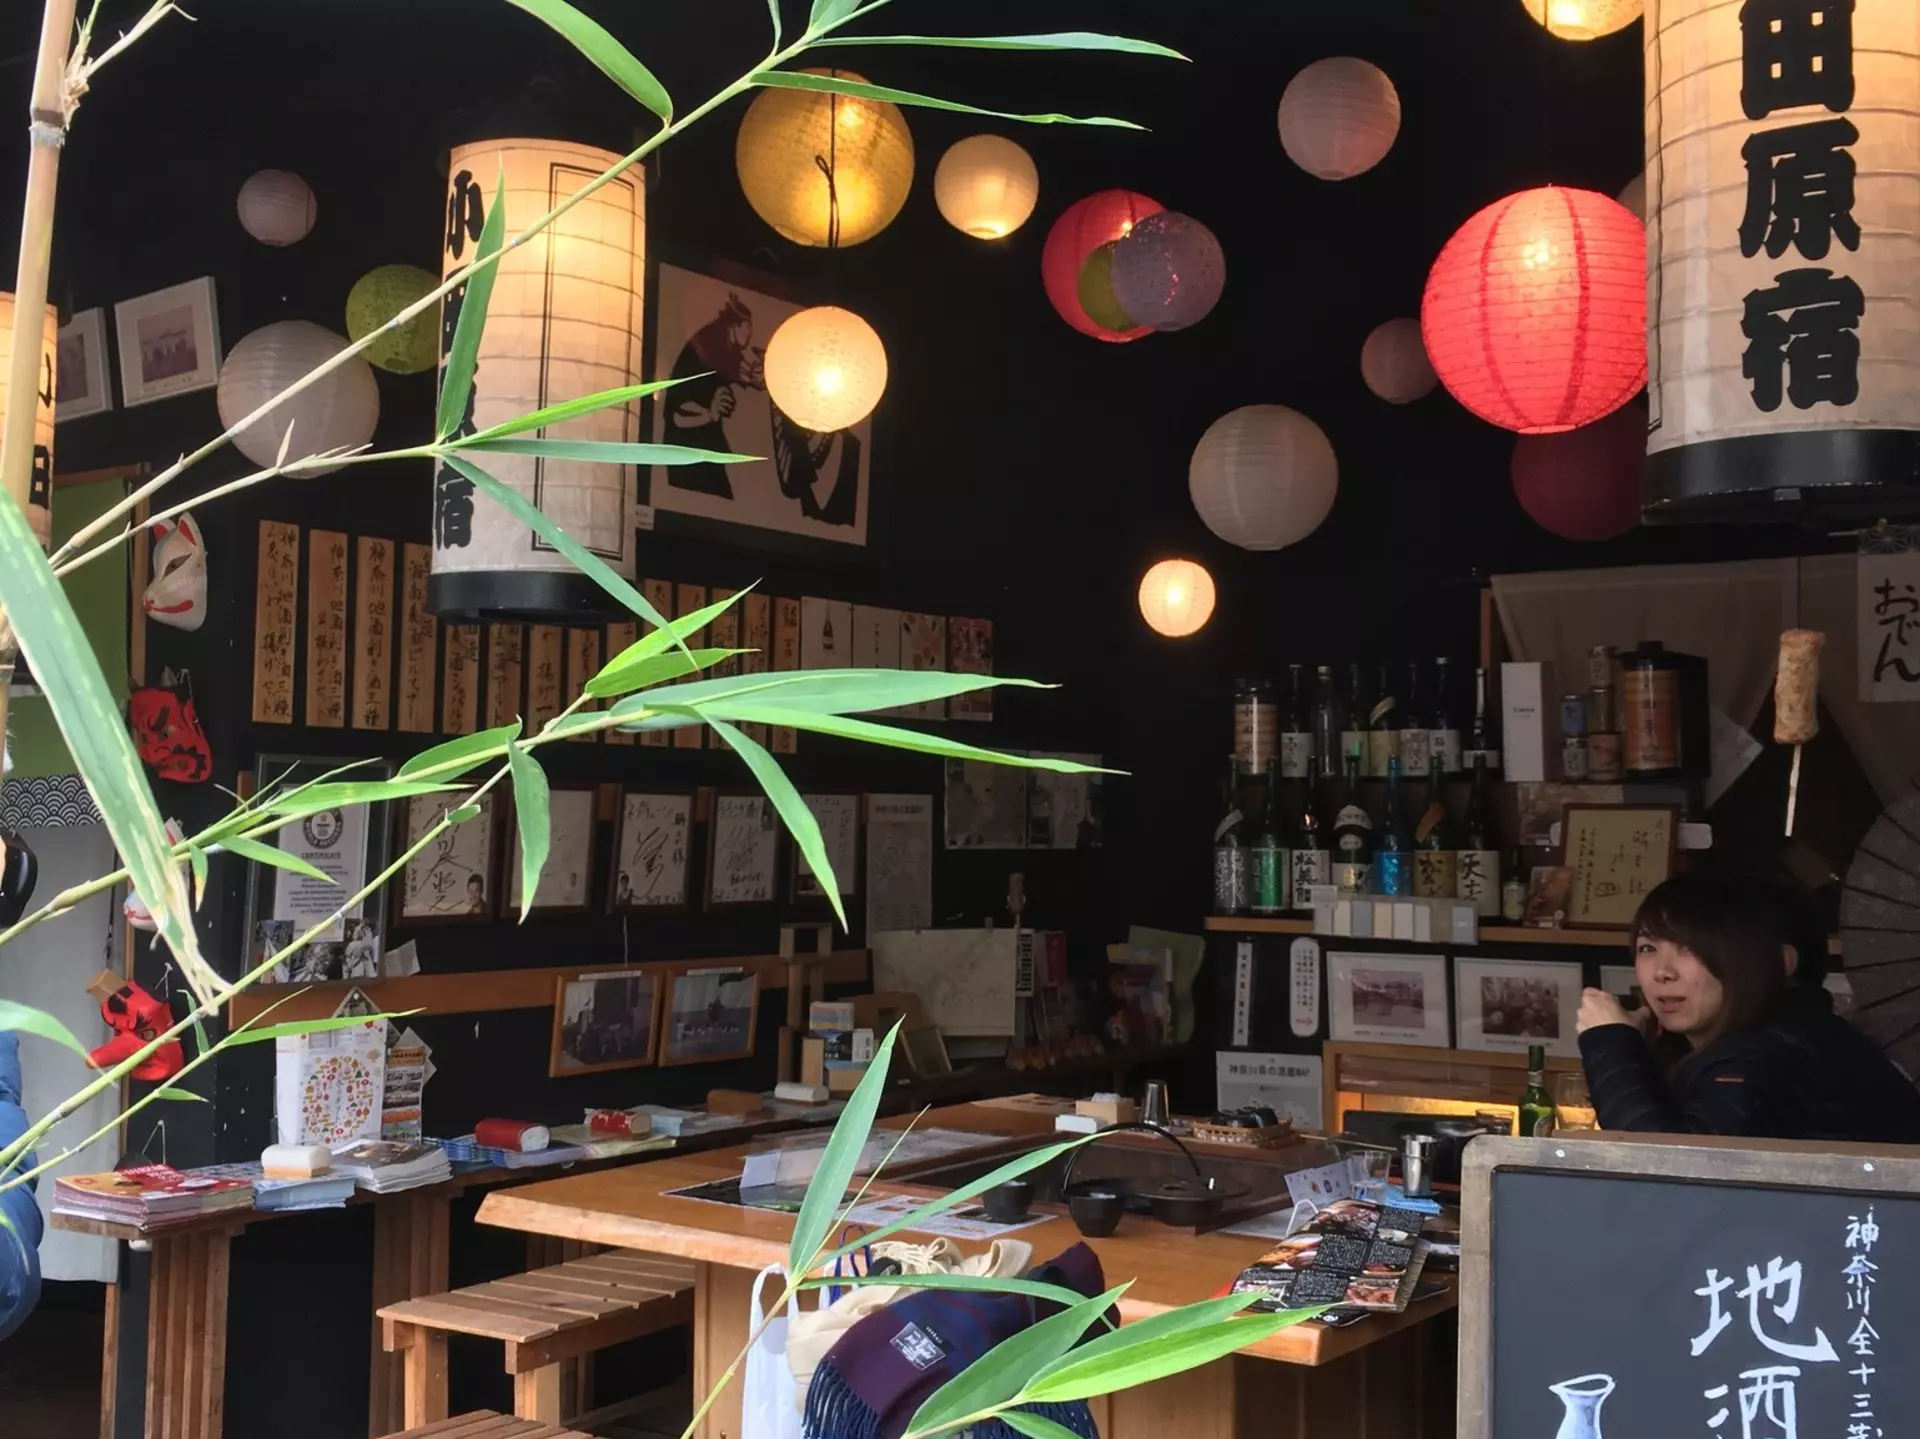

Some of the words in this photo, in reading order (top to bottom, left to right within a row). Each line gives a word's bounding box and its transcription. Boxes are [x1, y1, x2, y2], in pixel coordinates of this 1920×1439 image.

[1738, 0, 1866, 412] 田原宿
[1873, 577, 1920, 713] おでん
[1690, 1255, 1840, 1439] 地酒
